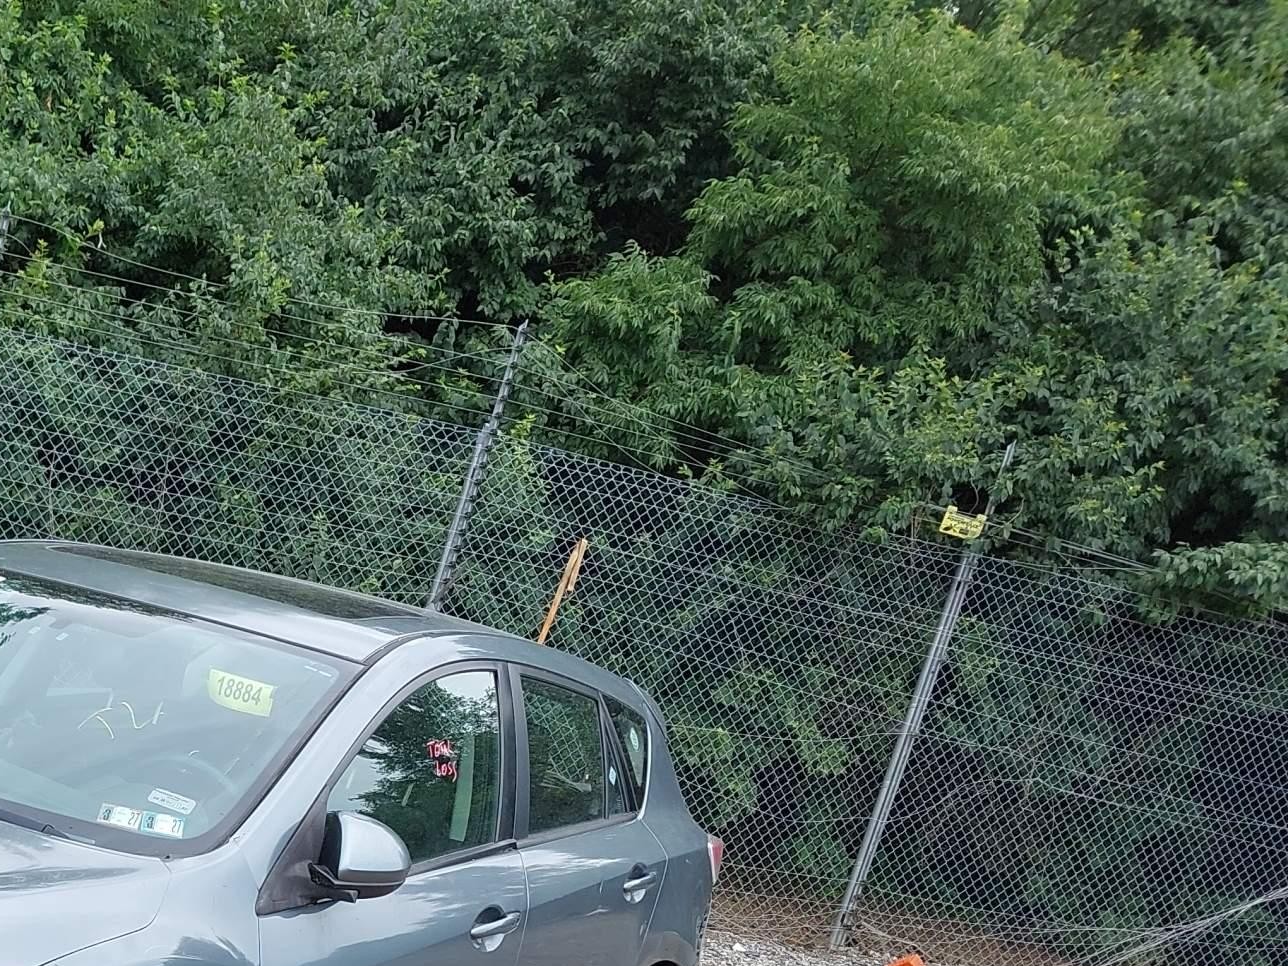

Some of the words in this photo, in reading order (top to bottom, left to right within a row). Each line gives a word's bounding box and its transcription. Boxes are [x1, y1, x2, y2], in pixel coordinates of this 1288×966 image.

[217, 676, 263, 706] 18884
[434, 760, 457, 783] LOSS
[102, 808, 111, 821] 3
[127, 812, 141, 826] 27
[146, 815, 155, 829] 3
[171, 818, 182, 834] 27
